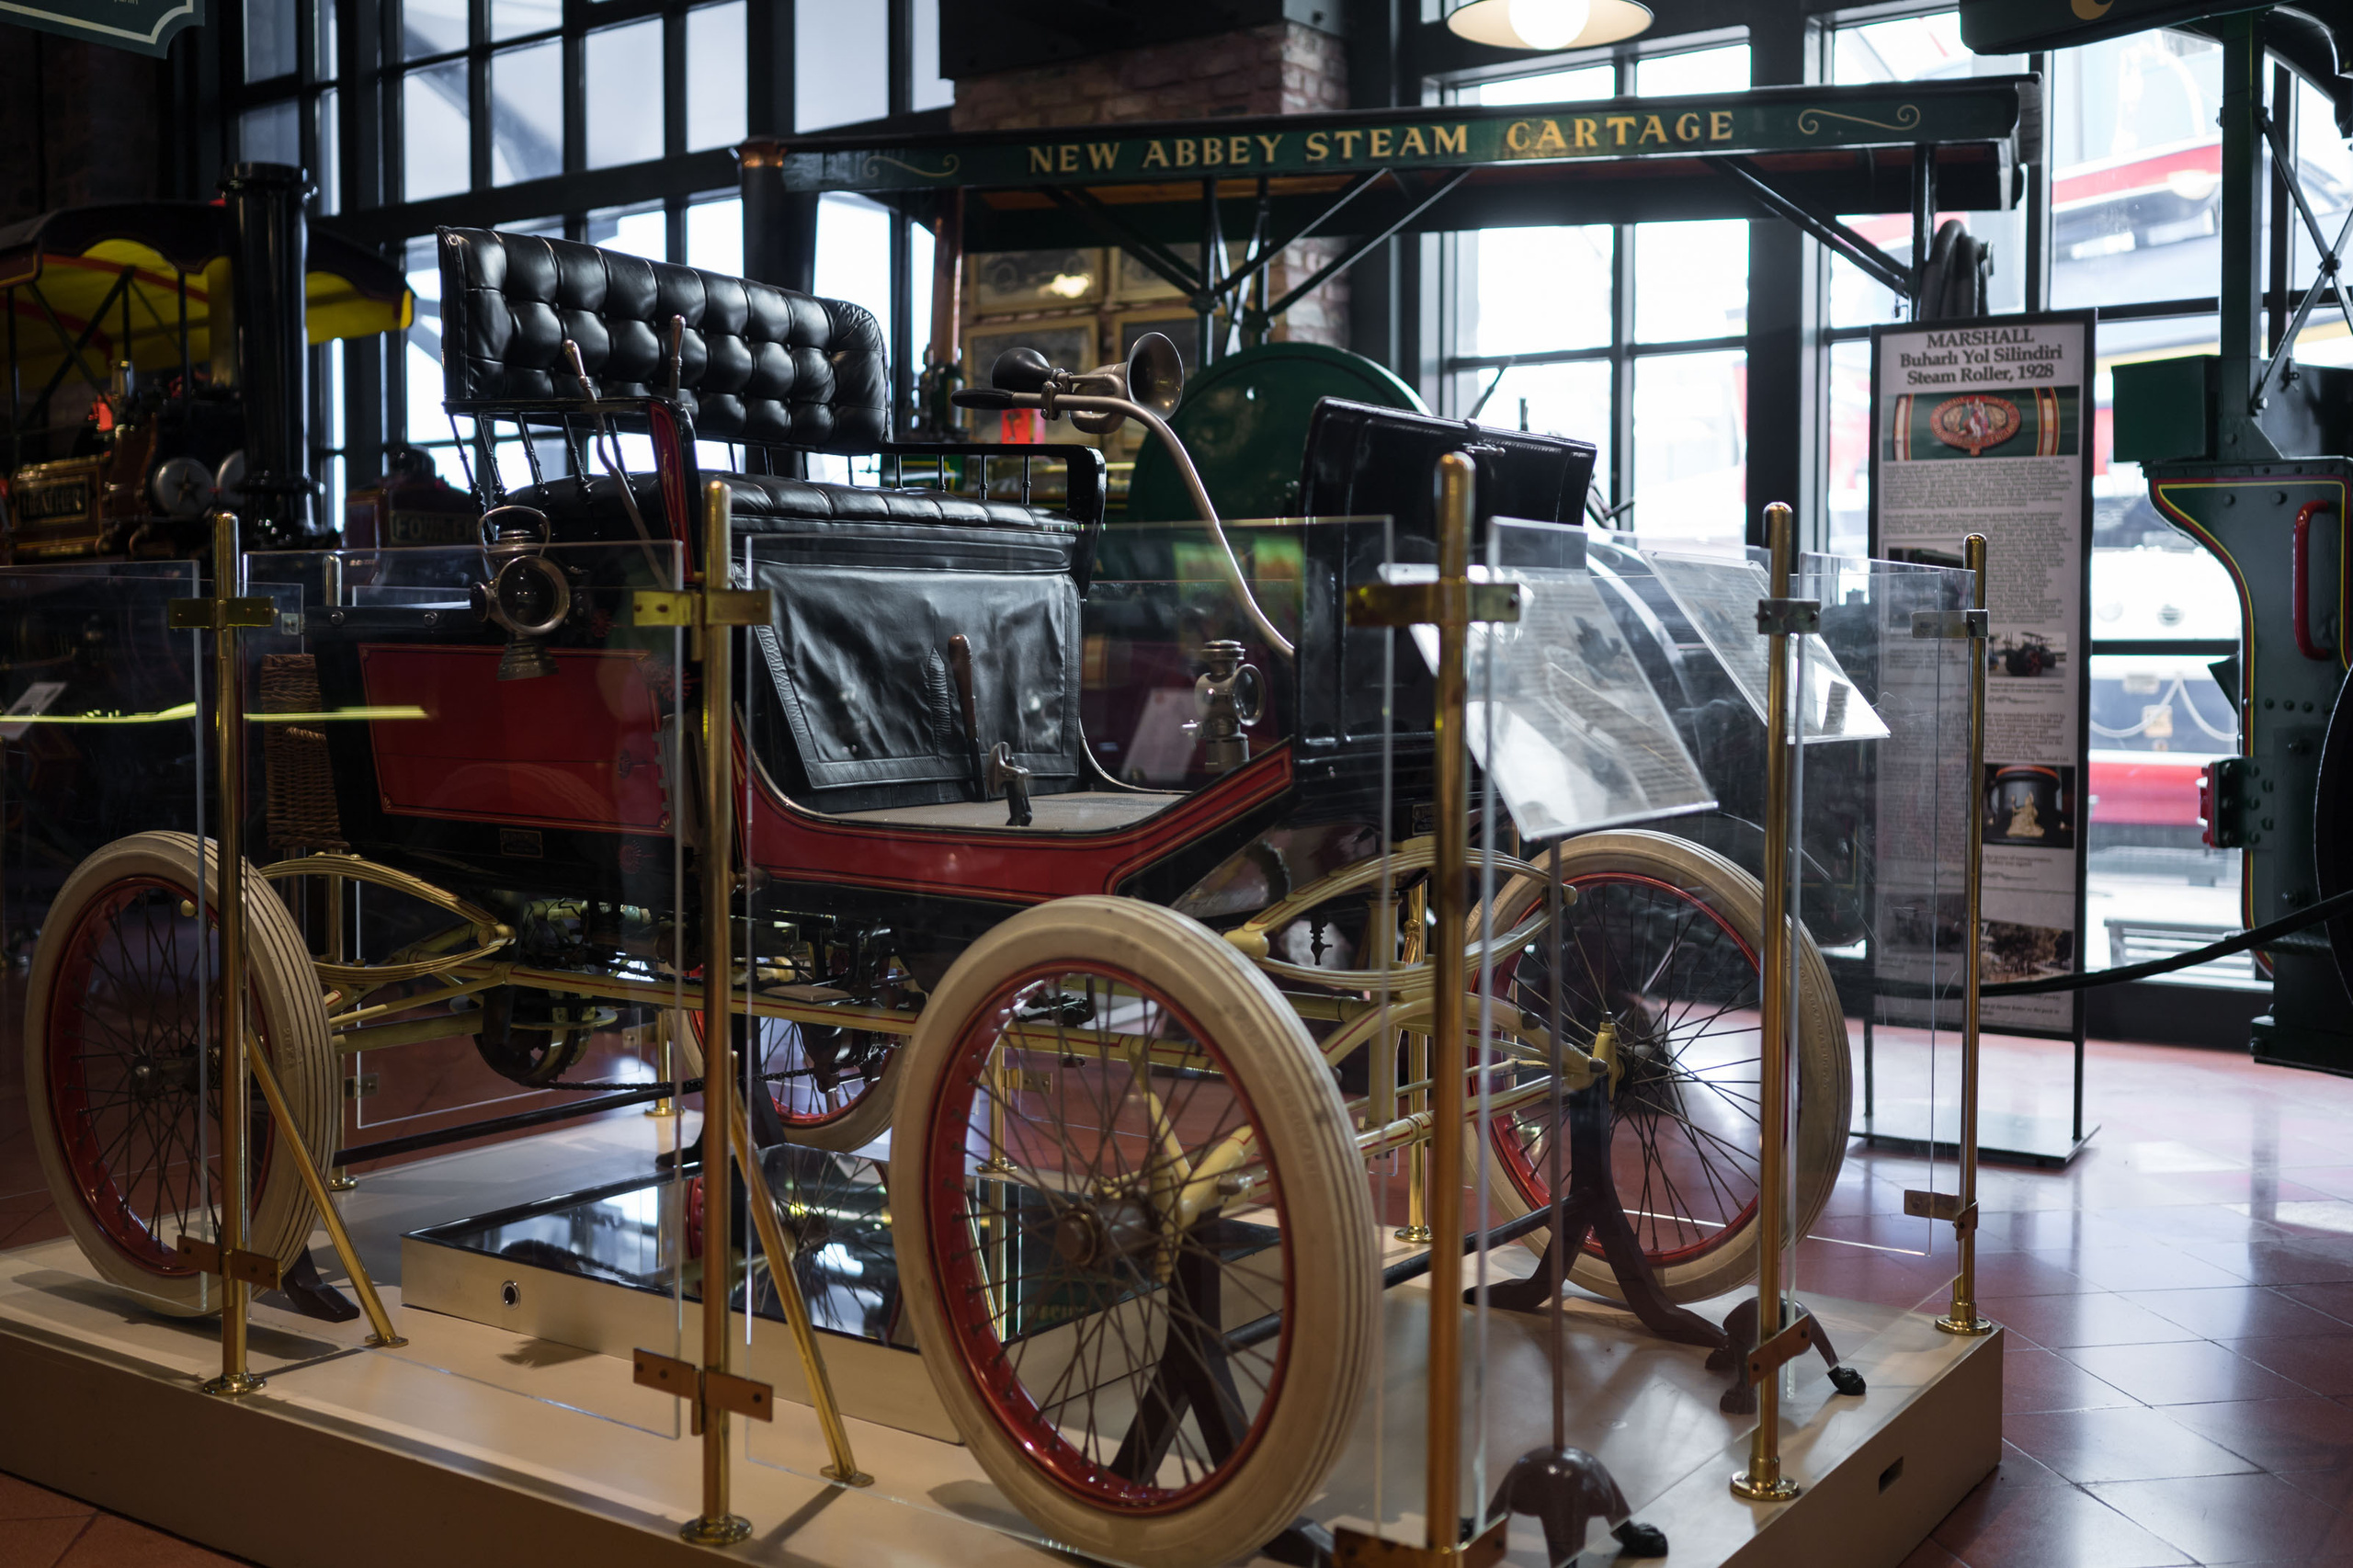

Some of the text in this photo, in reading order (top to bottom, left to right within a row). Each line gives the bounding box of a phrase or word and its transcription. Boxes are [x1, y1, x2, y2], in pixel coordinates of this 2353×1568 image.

[1028, 110, 1734, 173] NEW ABBEY STEAM CARTAGE
[1927, 328, 2035, 348] MARSHALL
[1900, 345, 2063, 369] Buharlı Yol Silindiri
[1906, 363, 2055, 385] Steam Roller, 1928
